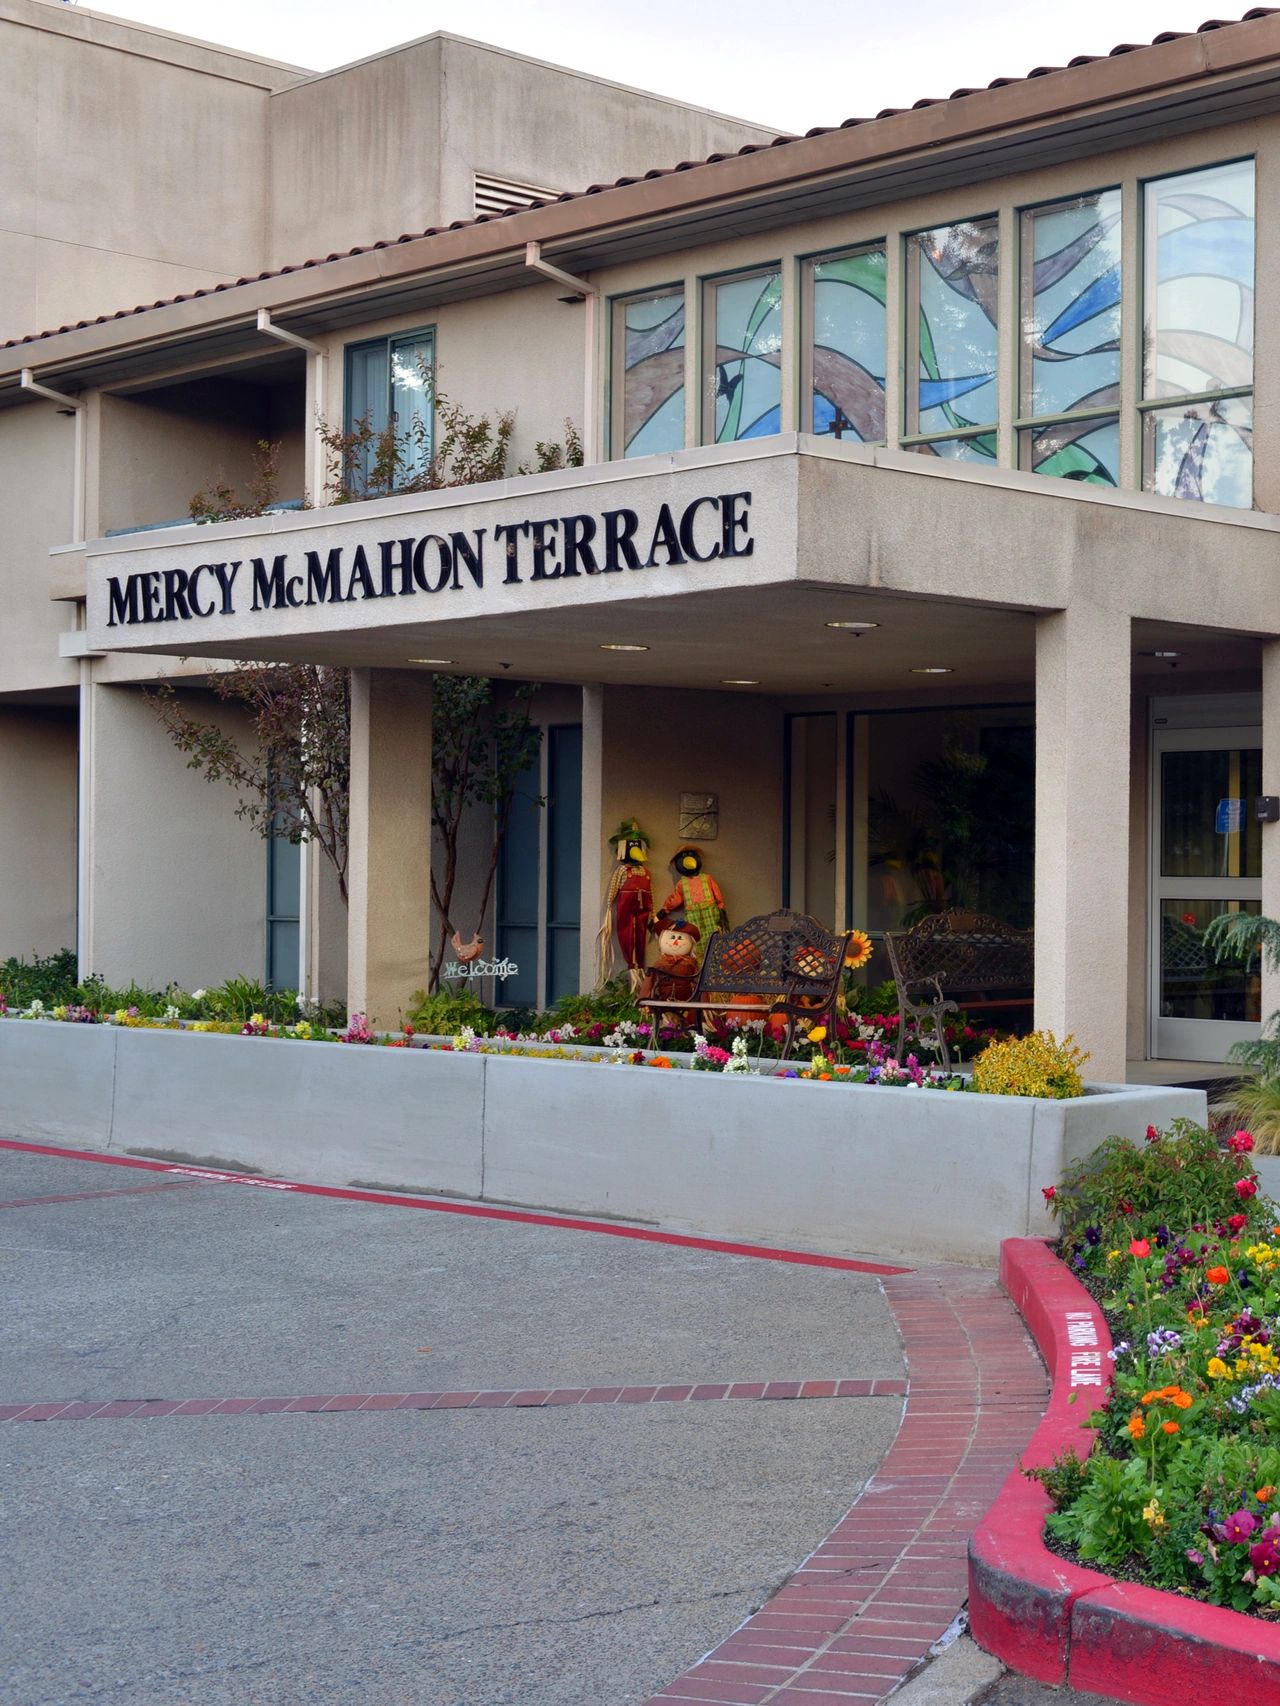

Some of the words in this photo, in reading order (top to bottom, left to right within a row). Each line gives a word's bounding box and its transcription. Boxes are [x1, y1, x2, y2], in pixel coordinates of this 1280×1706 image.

[106, 561, 243, 627] MERCY
[249, 528, 487, 611] McMAHON
[494, 491, 754, 584] TERRACE
[444, 959, 519, 979] Welcome
[1071, 1352, 1101, 1367] FIRE
[1071, 1368, 1102, 1387] LANE
